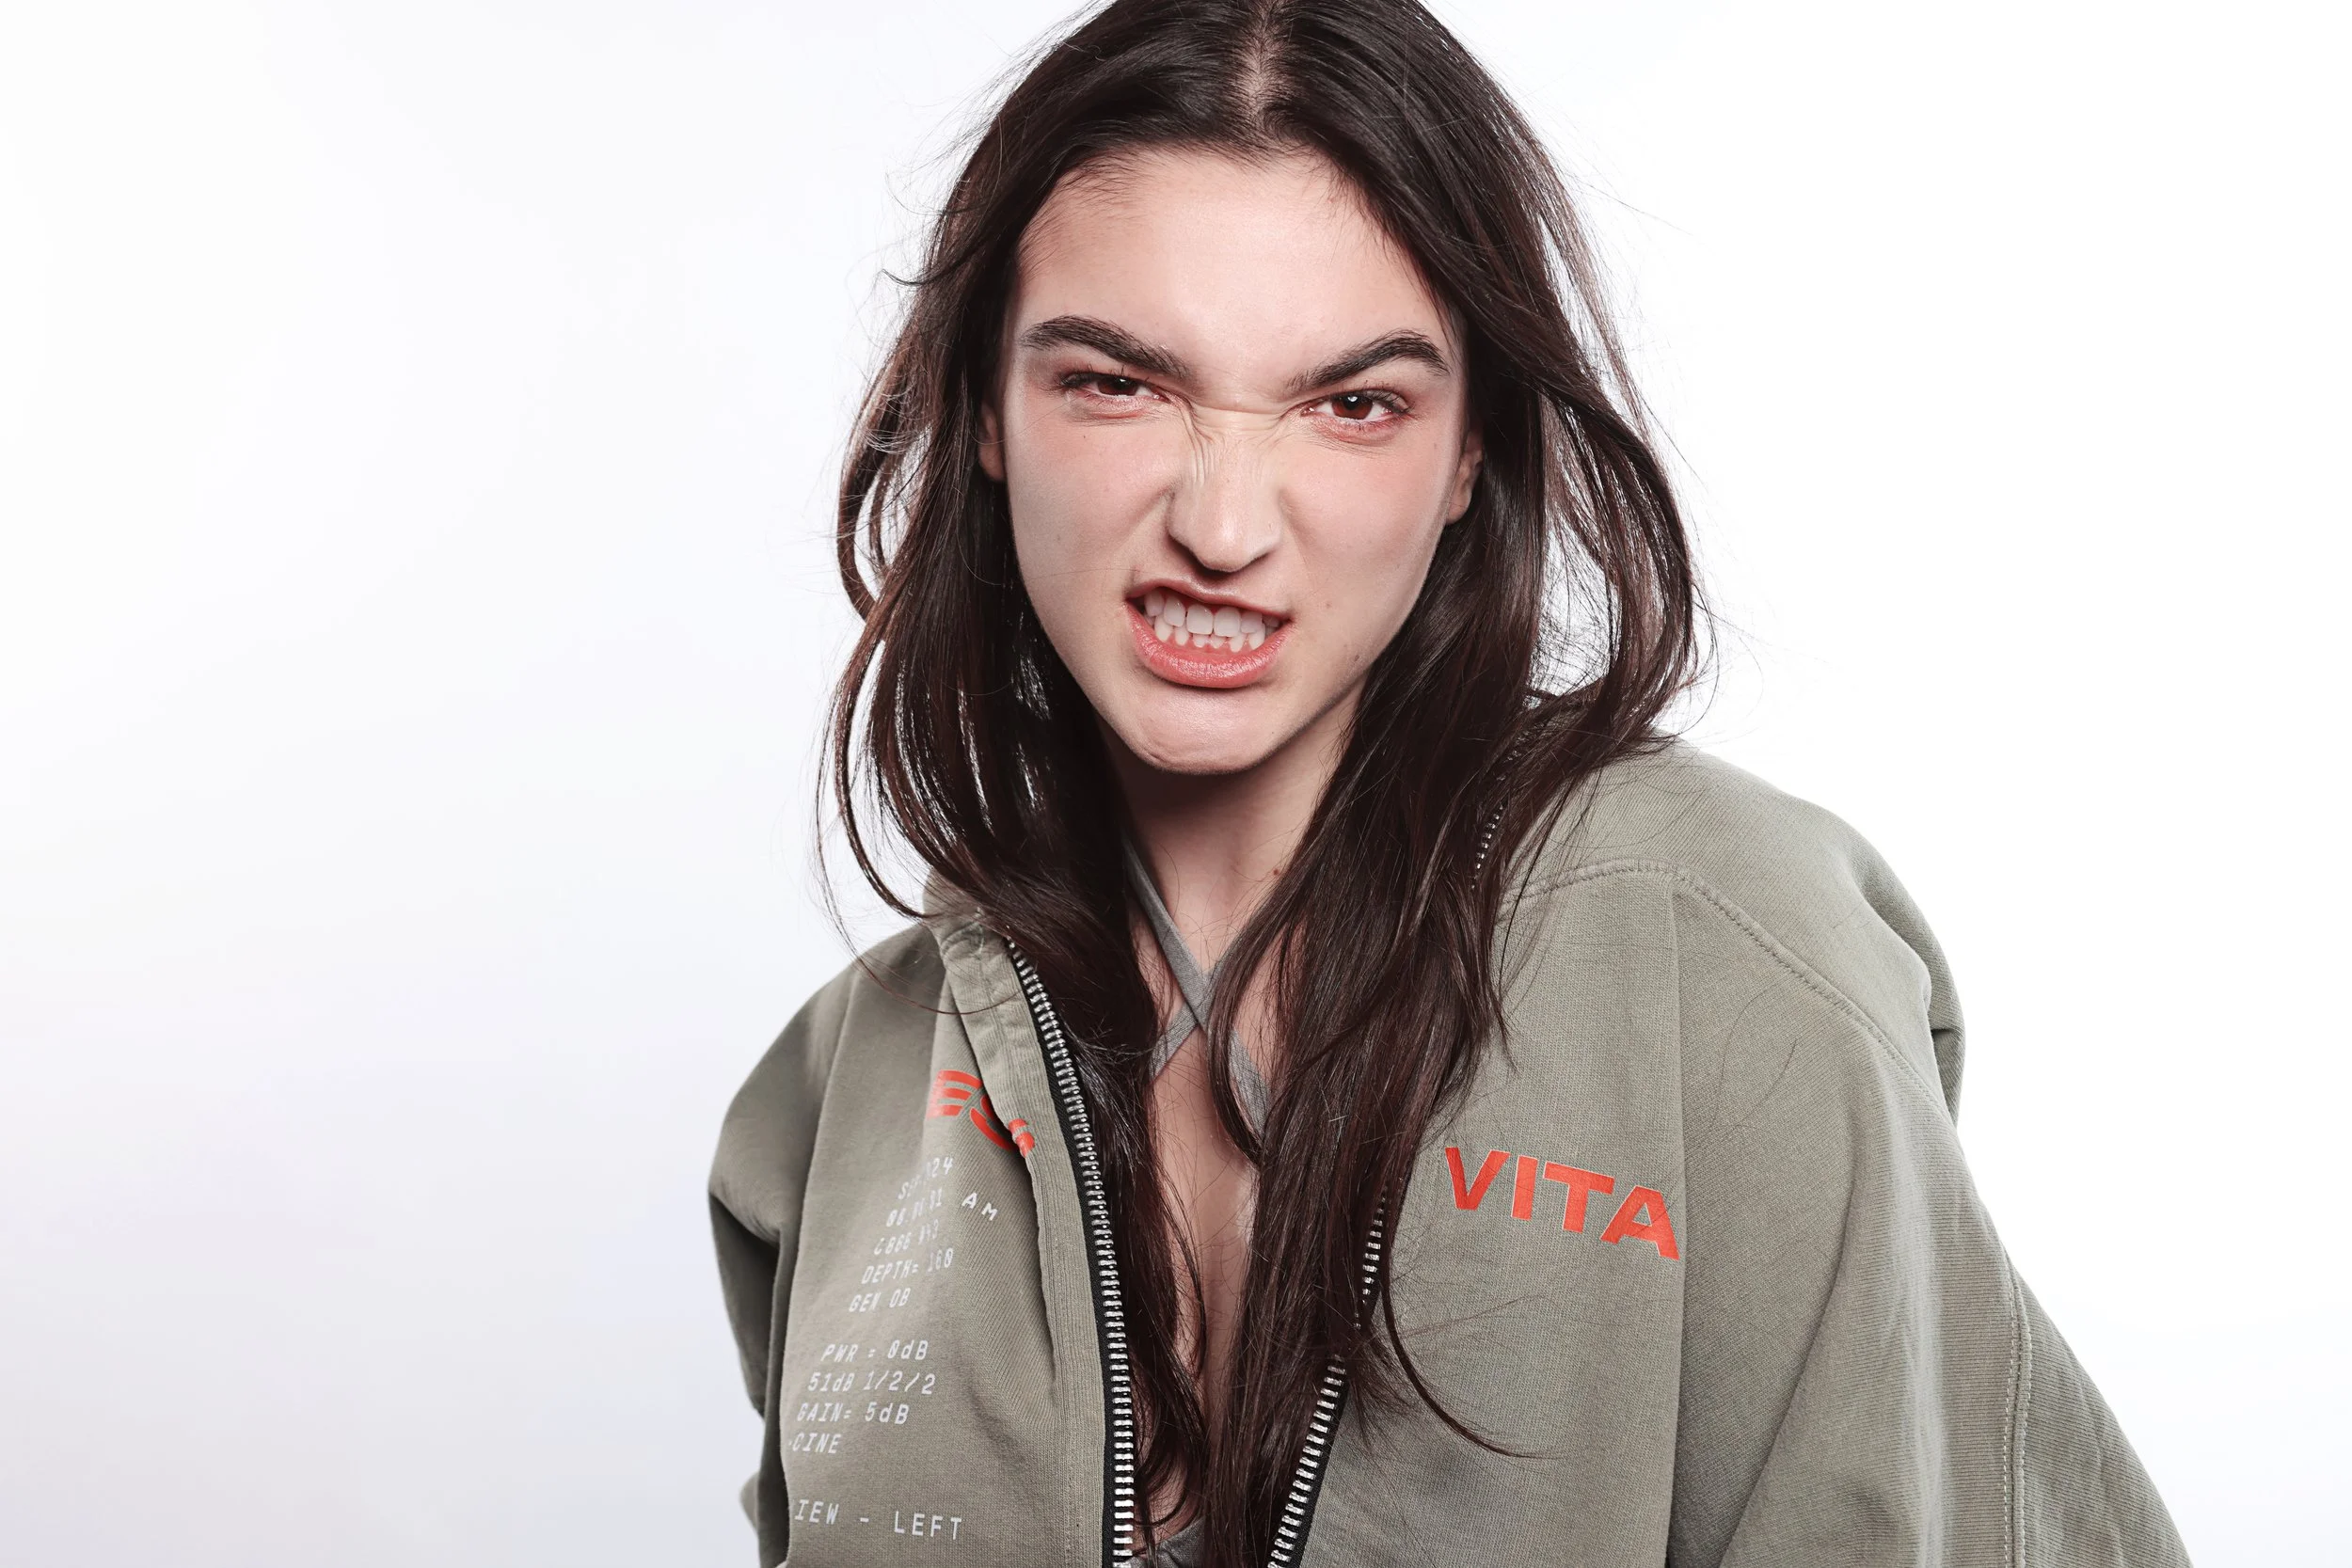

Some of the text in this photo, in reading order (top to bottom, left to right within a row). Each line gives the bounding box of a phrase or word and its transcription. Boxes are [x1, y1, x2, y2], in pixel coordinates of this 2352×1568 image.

[961, 1192, 998, 1221] AM
[1444, 1146, 1680, 1260] VITA
[849, 1291, 881, 1313] GEN
[820, 1343, 859, 1363] PWR
[807, 1370, 936, 1396] 51dB 1/2/2
[865, 1402, 910, 1425] 5dB
[788, 1433, 842, 1455] CINE
[793, 1498, 839, 1526] IEW
[893, 1510, 962, 1541] LEFT
